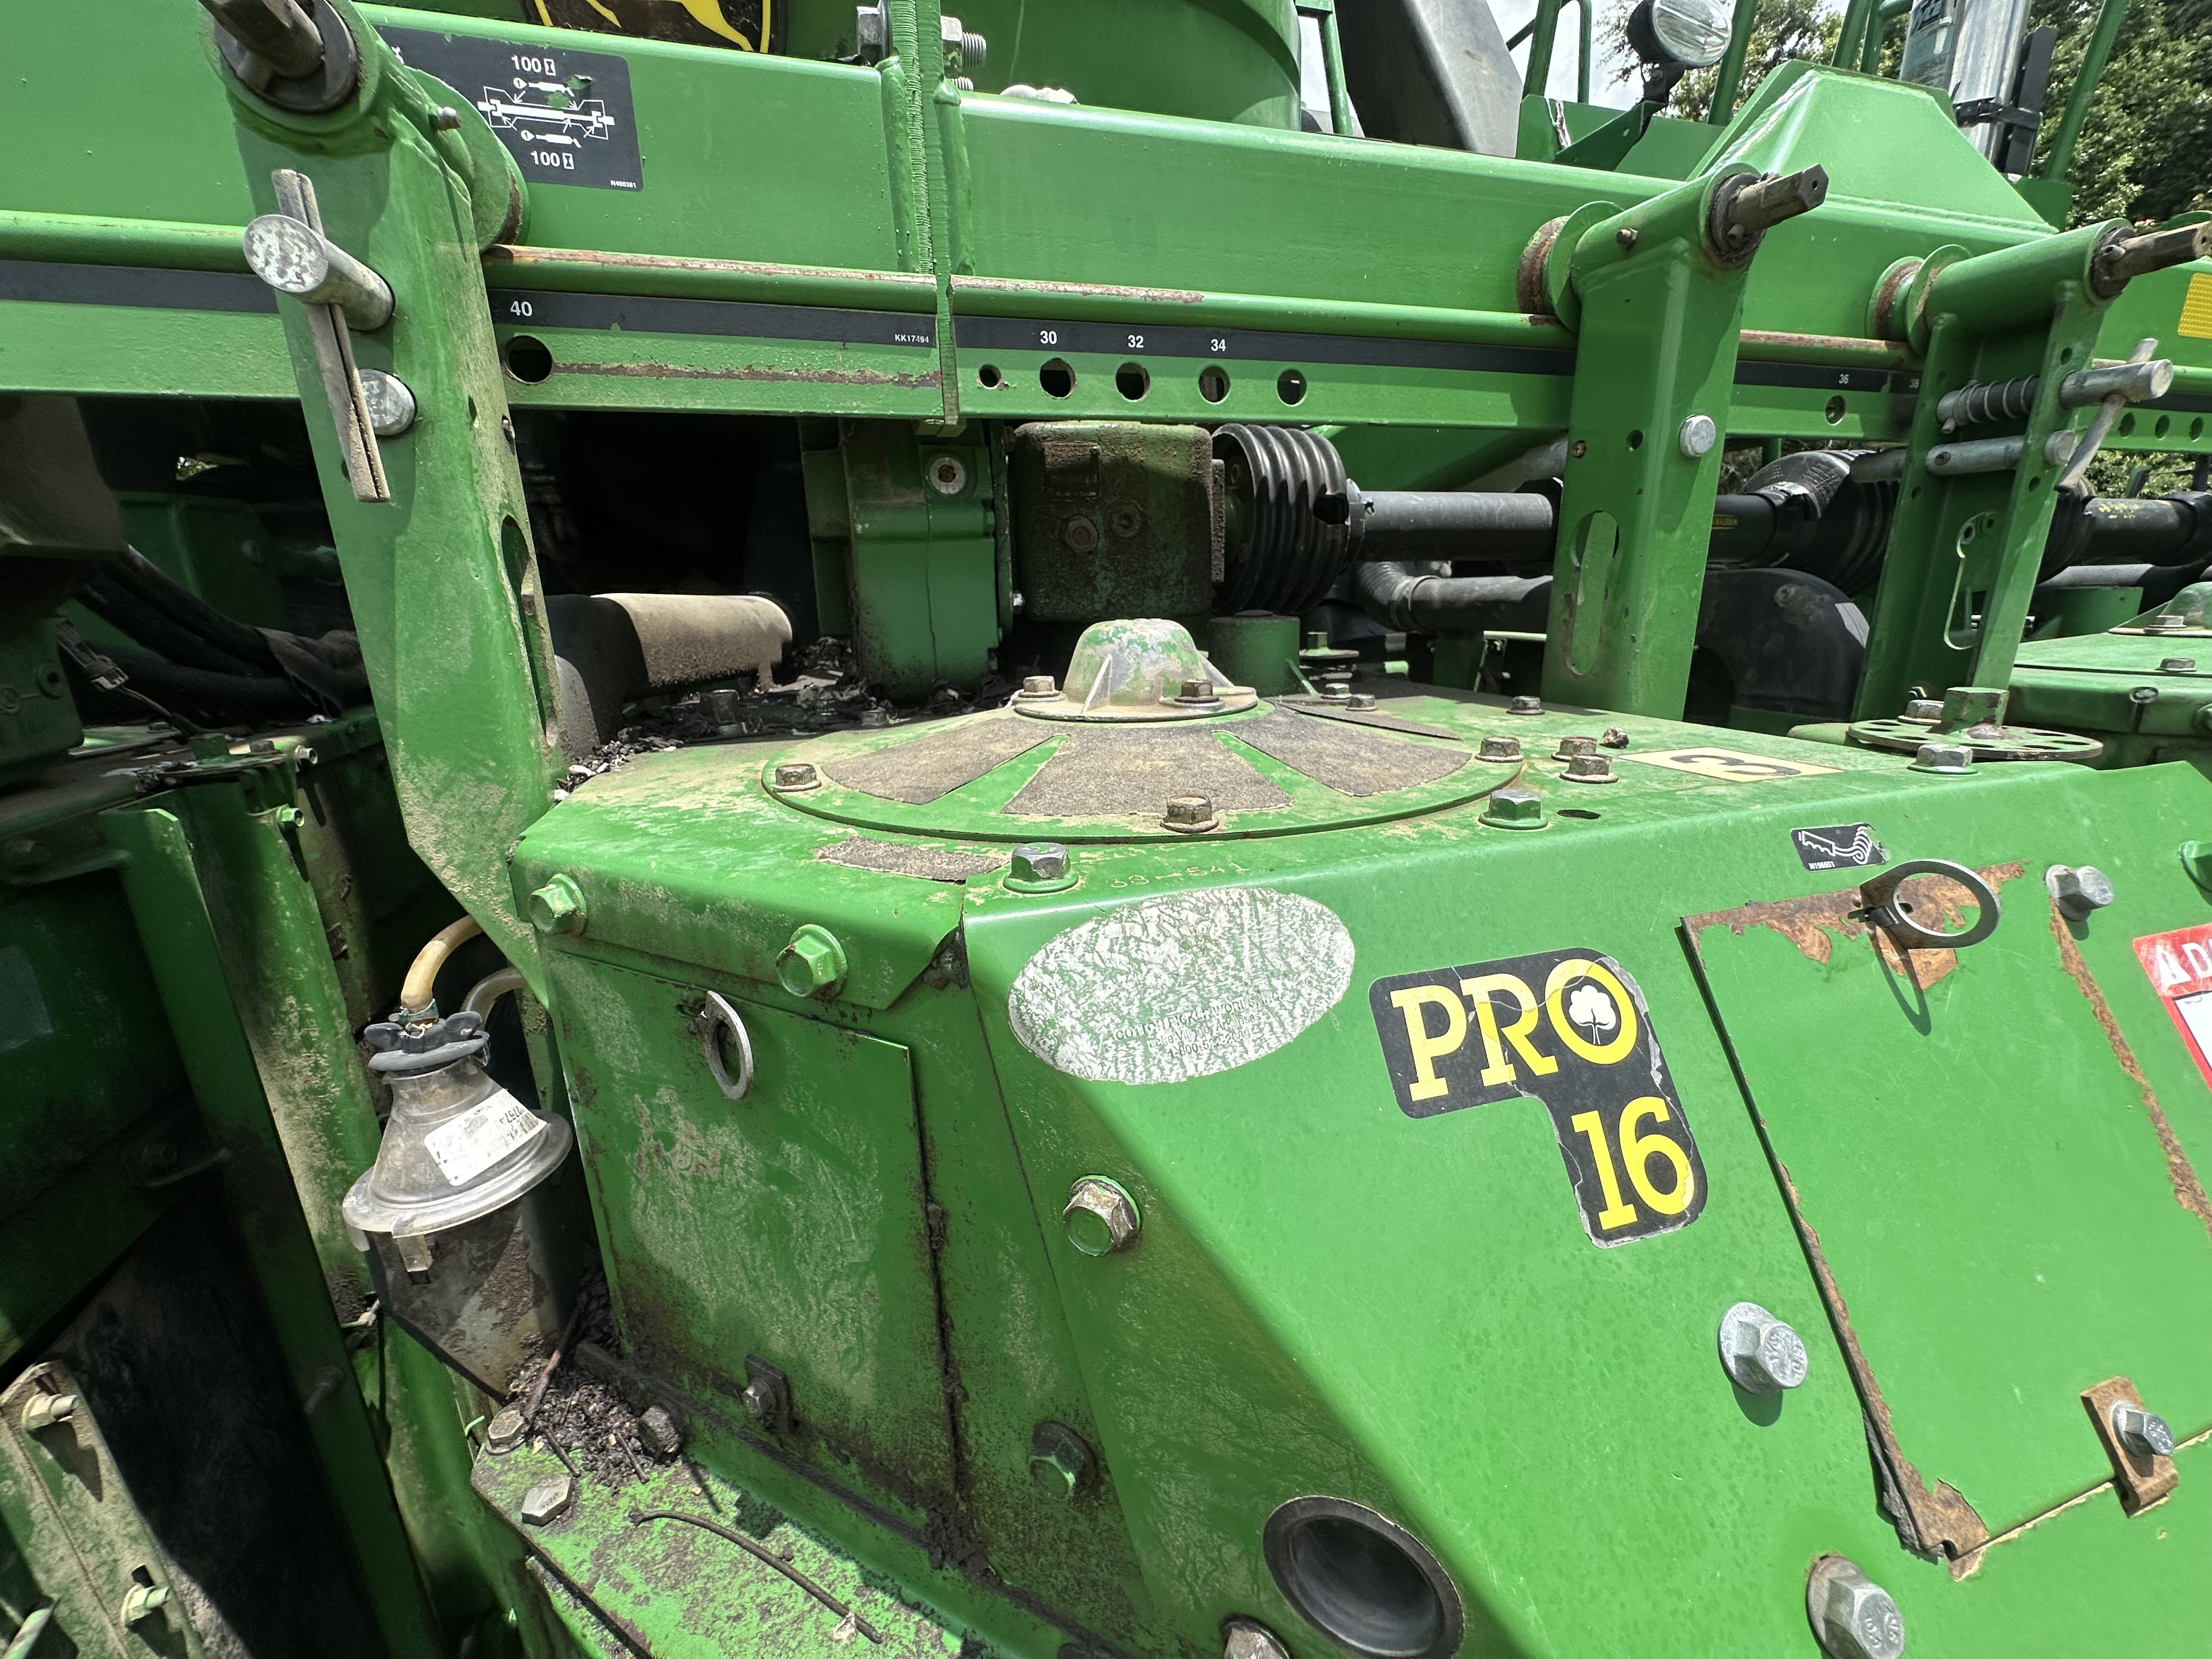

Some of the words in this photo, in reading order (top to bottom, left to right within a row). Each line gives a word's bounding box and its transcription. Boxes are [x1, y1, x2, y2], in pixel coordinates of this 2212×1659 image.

[511, 54, 541, 73] 100
[531, 150, 560, 167] 100
[510, 300, 533, 317] 40
[1040, 331, 1058, 345] 30
[1127, 335, 1144, 348] 32
[1210, 338, 1226, 352] 34
[1838, 374, 1849, 384] 36
[1909, 378, 1920, 388] 38
[1390, 958, 1637, 1102] PRO
[1571, 1096, 1695, 1231] 16
